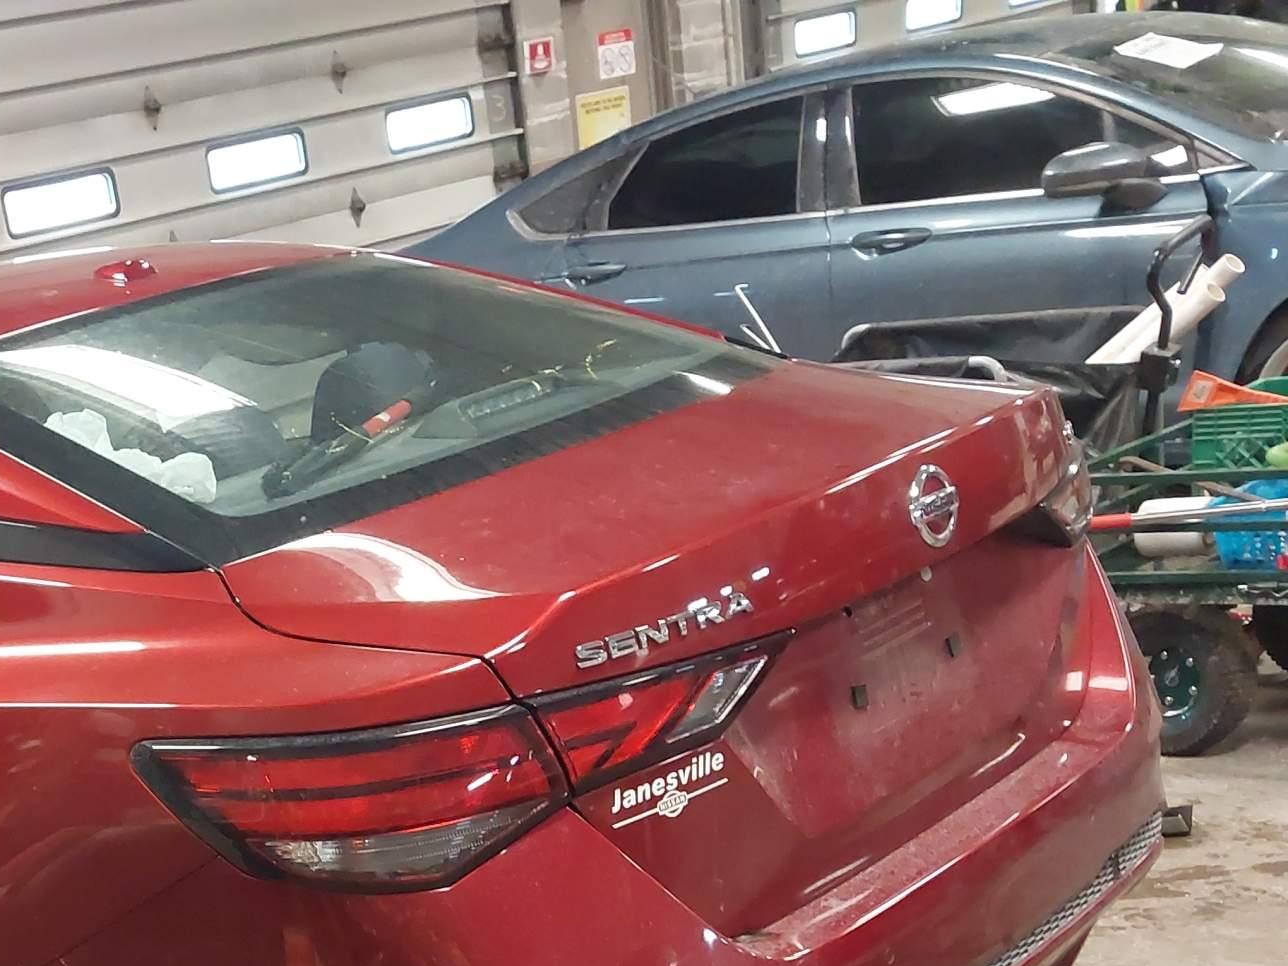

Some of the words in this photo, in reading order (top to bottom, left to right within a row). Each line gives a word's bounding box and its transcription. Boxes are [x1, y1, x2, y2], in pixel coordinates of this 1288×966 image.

[489, 95, 506, 121] 3
[575, 592, 755, 669] SENTRA
[611, 751, 725, 814] Janesville
[658, 793, 687, 812] NISSAN
